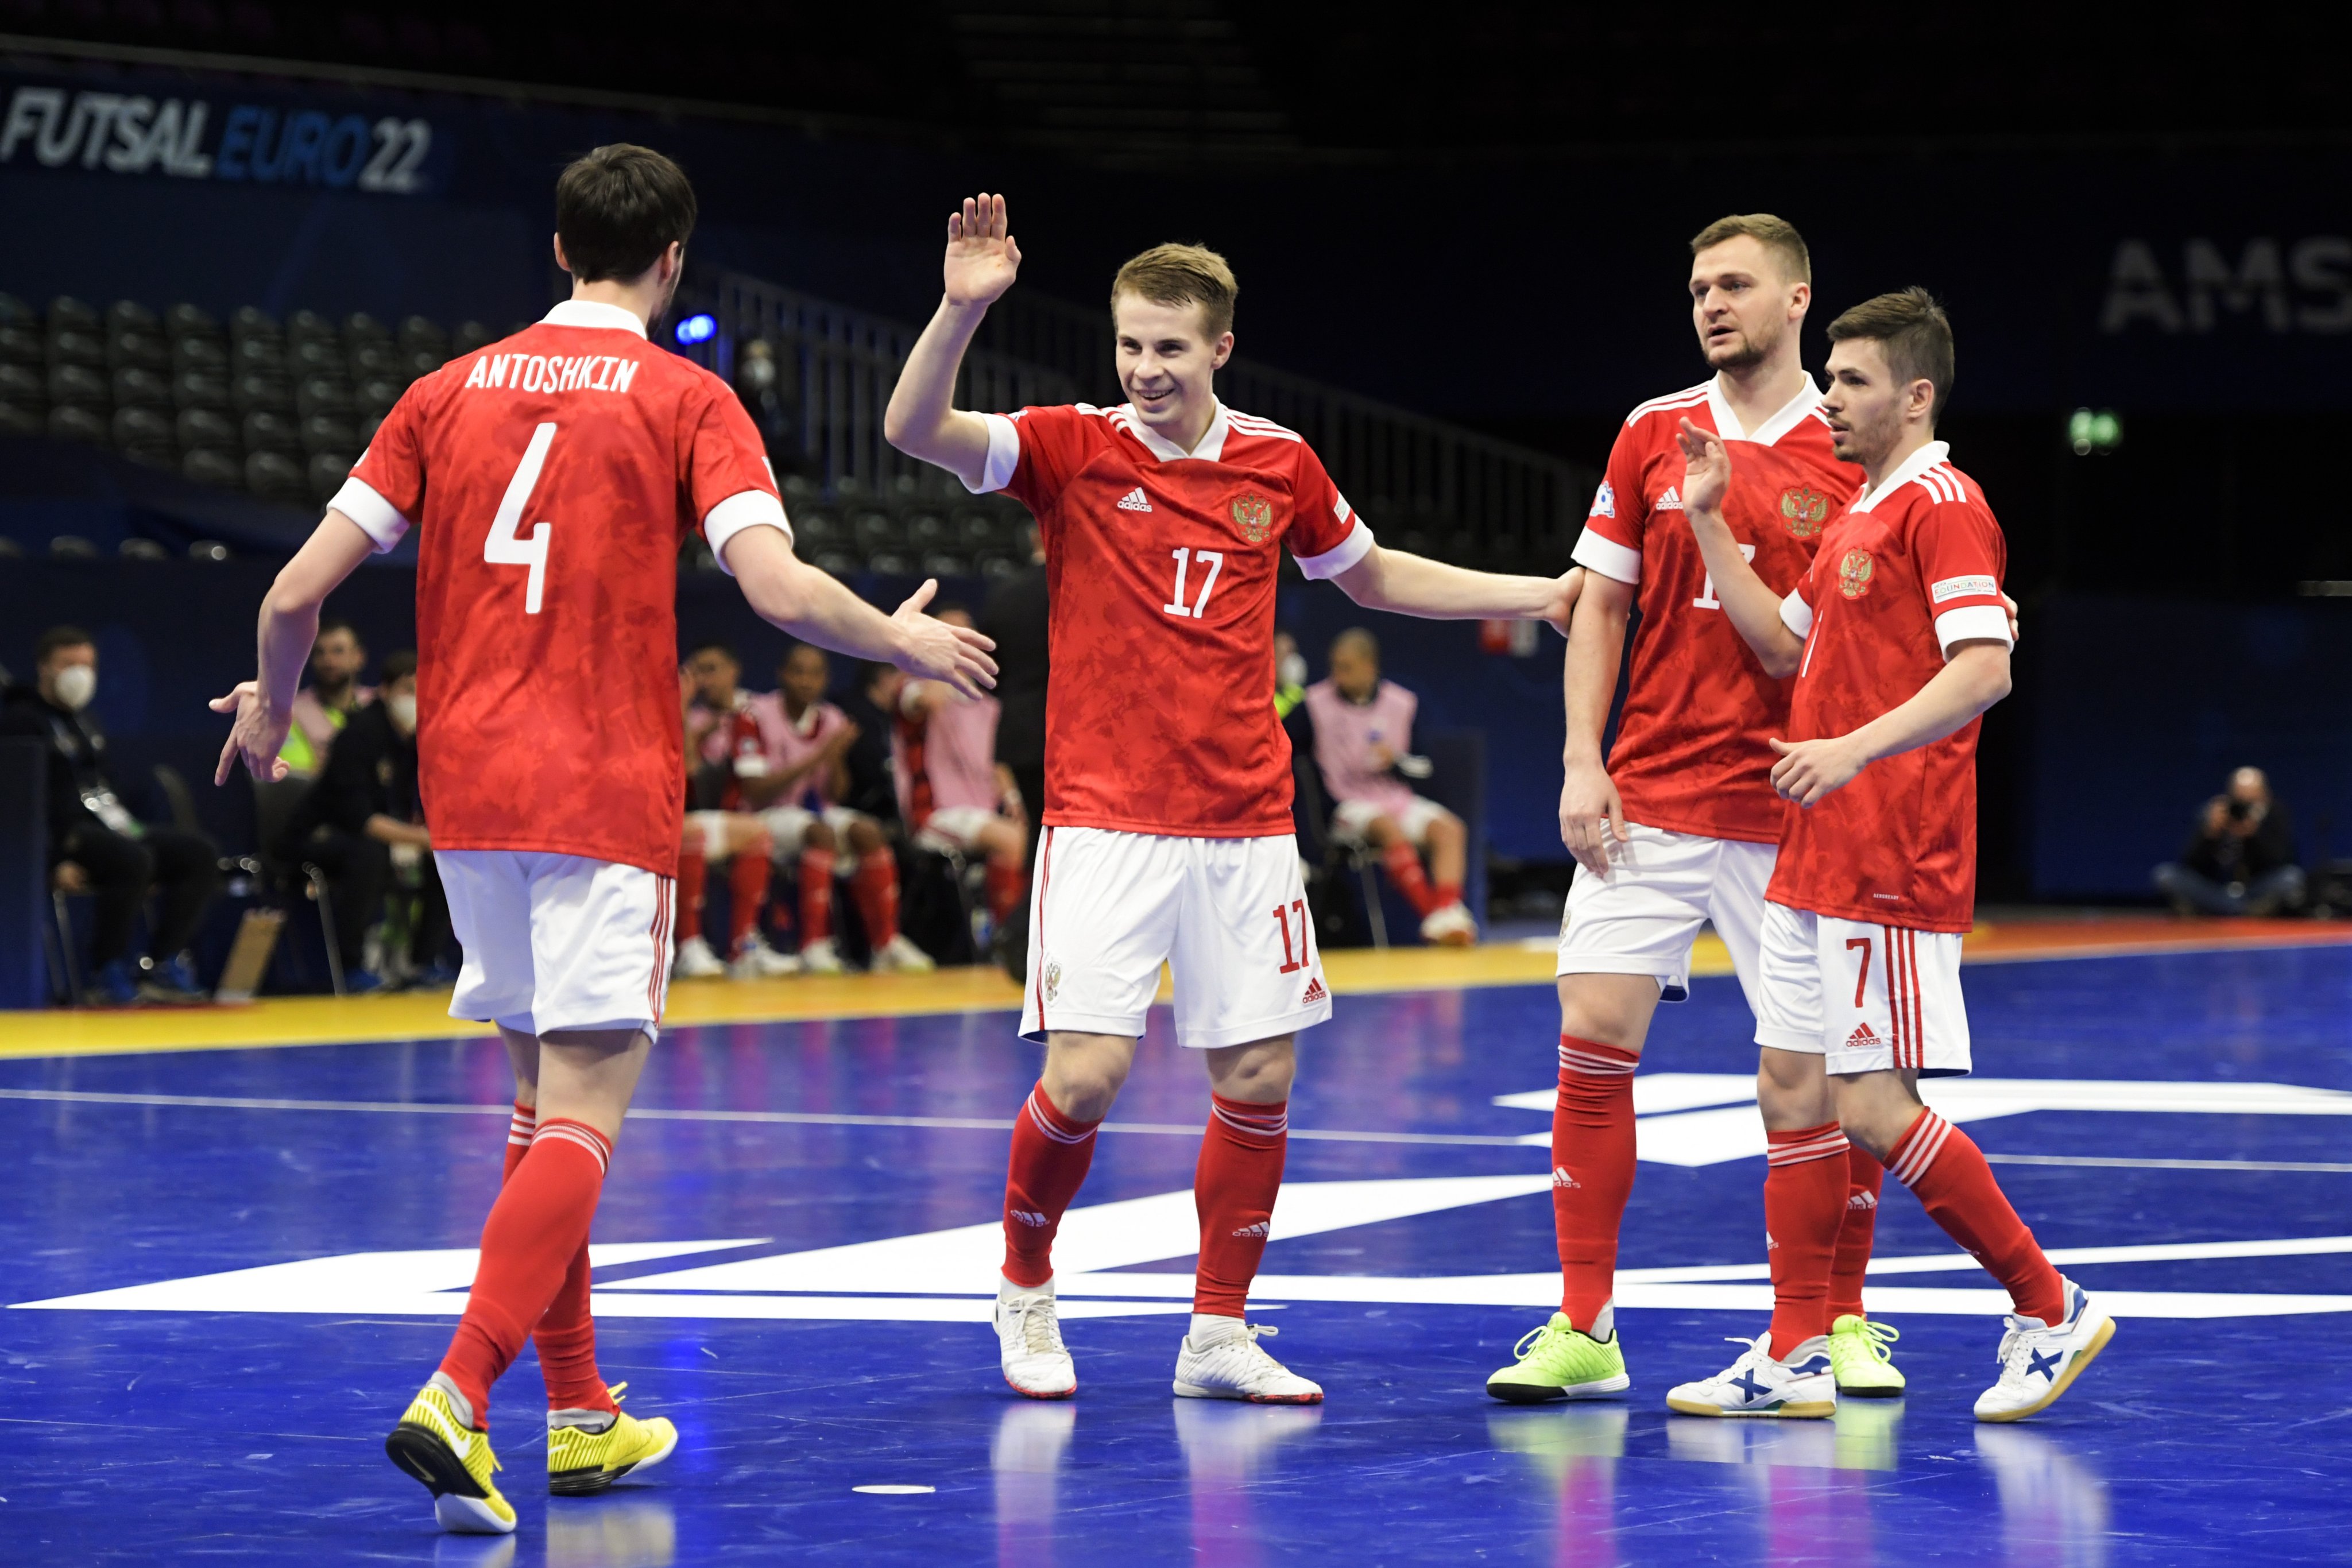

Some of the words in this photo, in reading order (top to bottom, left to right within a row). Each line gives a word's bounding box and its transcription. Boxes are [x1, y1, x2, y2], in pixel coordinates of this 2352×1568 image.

[1, 86, 214, 177] FUTSAL
[465, 353, 638, 394] ANTOSHKIN
[483, 422, 557, 614] 4
[1117, 501, 1152, 513] adidas
[1163, 547, 1223, 619] 17
[1935, 581, 1994, 595] FOUNDATION
[1273, 899, 1309, 974] 17
[1302, 991, 1326, 1004] adidas
[1846, 938, 1872, 1008] 7
[1846, 1037, 1881, 1047] adidas
